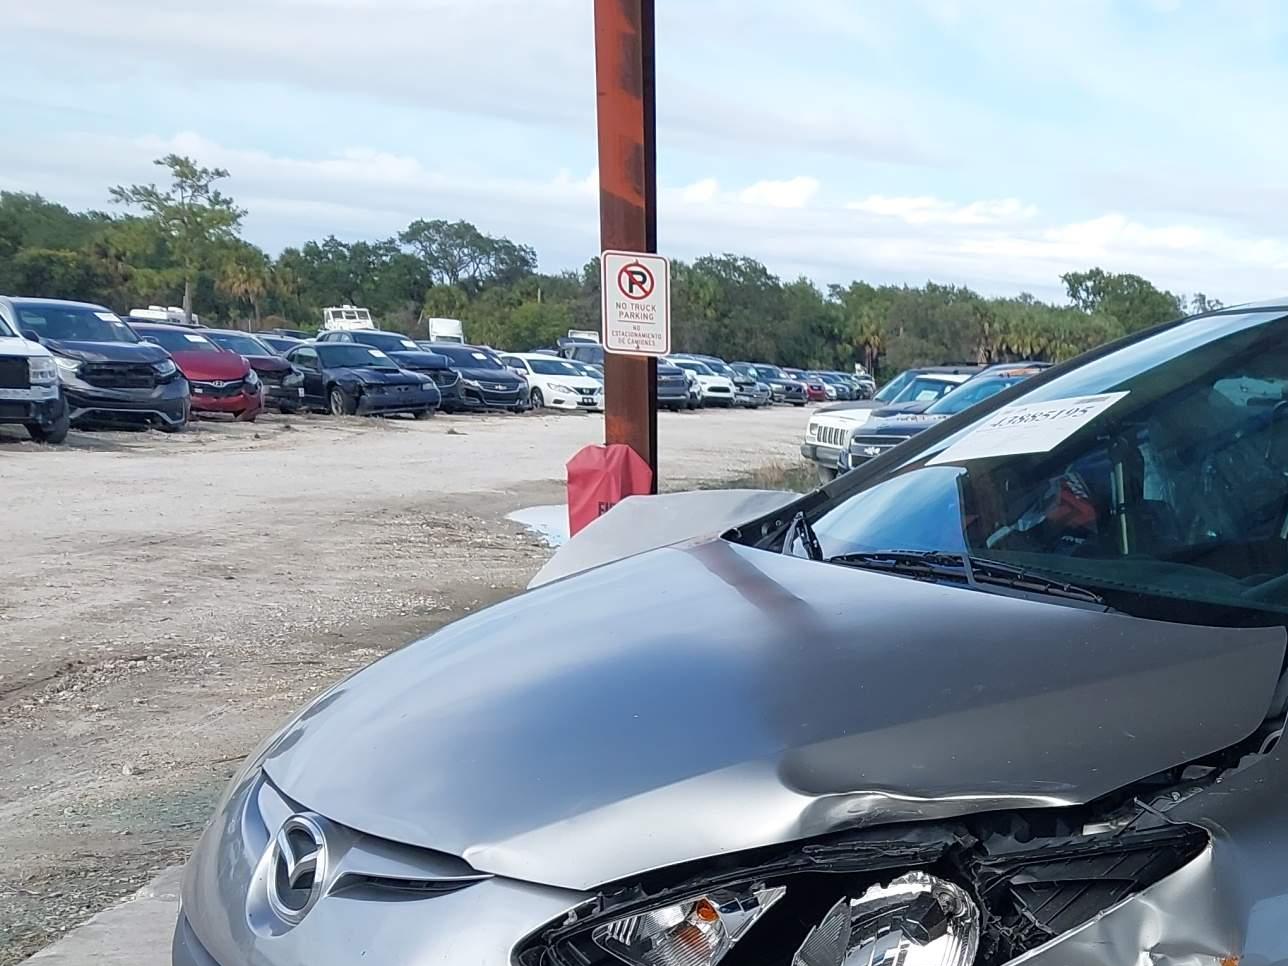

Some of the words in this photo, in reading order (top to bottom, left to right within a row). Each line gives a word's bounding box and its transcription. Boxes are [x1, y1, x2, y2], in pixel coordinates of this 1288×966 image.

[616, 302, 627, 310] NO
[630, 303, 657, 312] TRUCK
[618, 311, 654, 320] PARKING
[611, 330, 662, 340] ESTACIONAMIENTO
